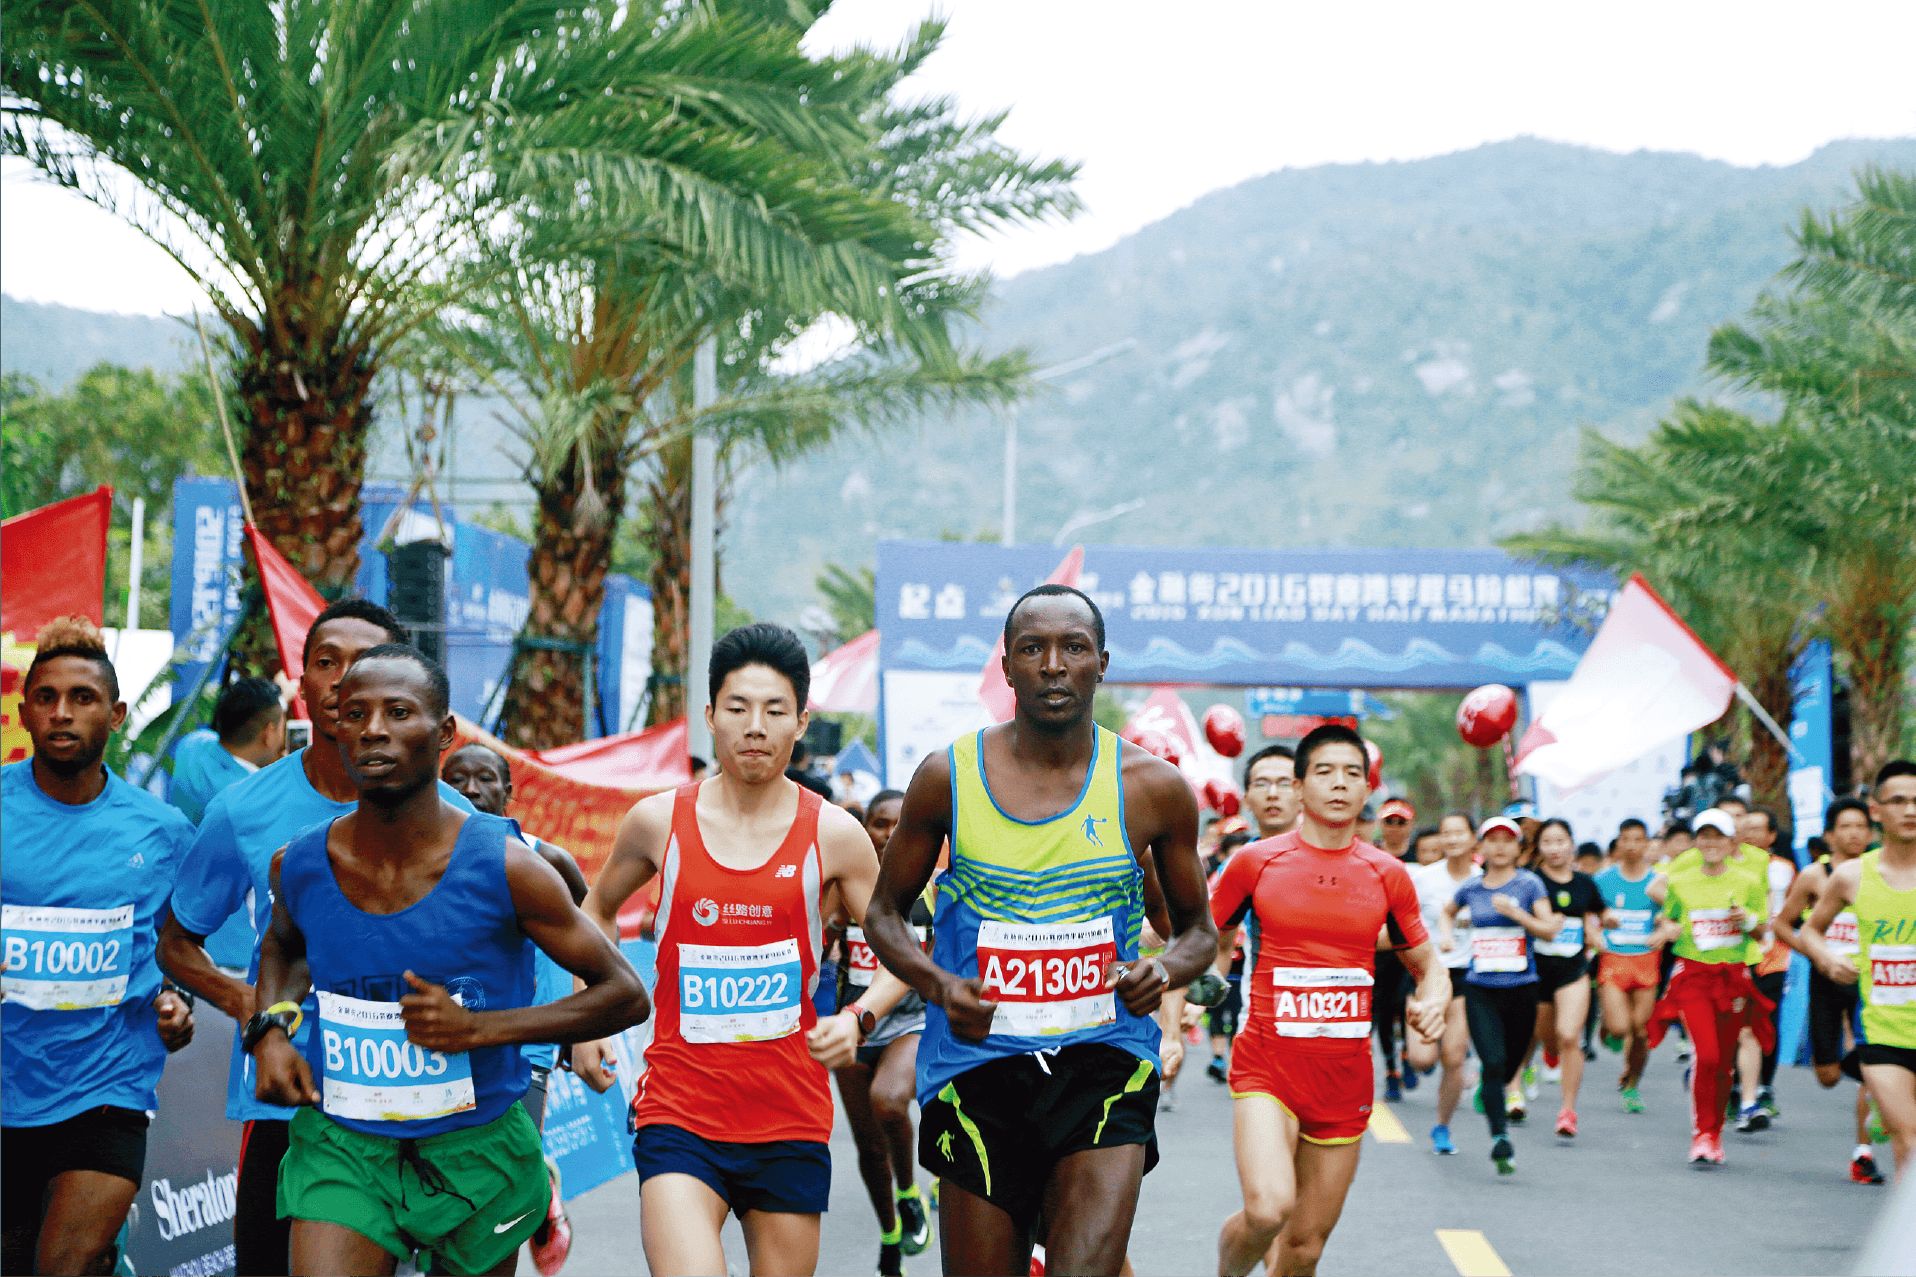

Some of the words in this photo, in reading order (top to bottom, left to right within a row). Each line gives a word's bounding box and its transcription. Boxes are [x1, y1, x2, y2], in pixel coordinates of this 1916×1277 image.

[899, 583, 965, 619] 起点
[722, 903, 773, 918] 丝路创意
[4, 936, 121, 974] B10002
[683, 972, 788, 1009] B10222
[984, 953, 1100, 996] A21305
[1275, 990, 1359, 1019] A10321
[323, 1029, 448, 1079] B10003
